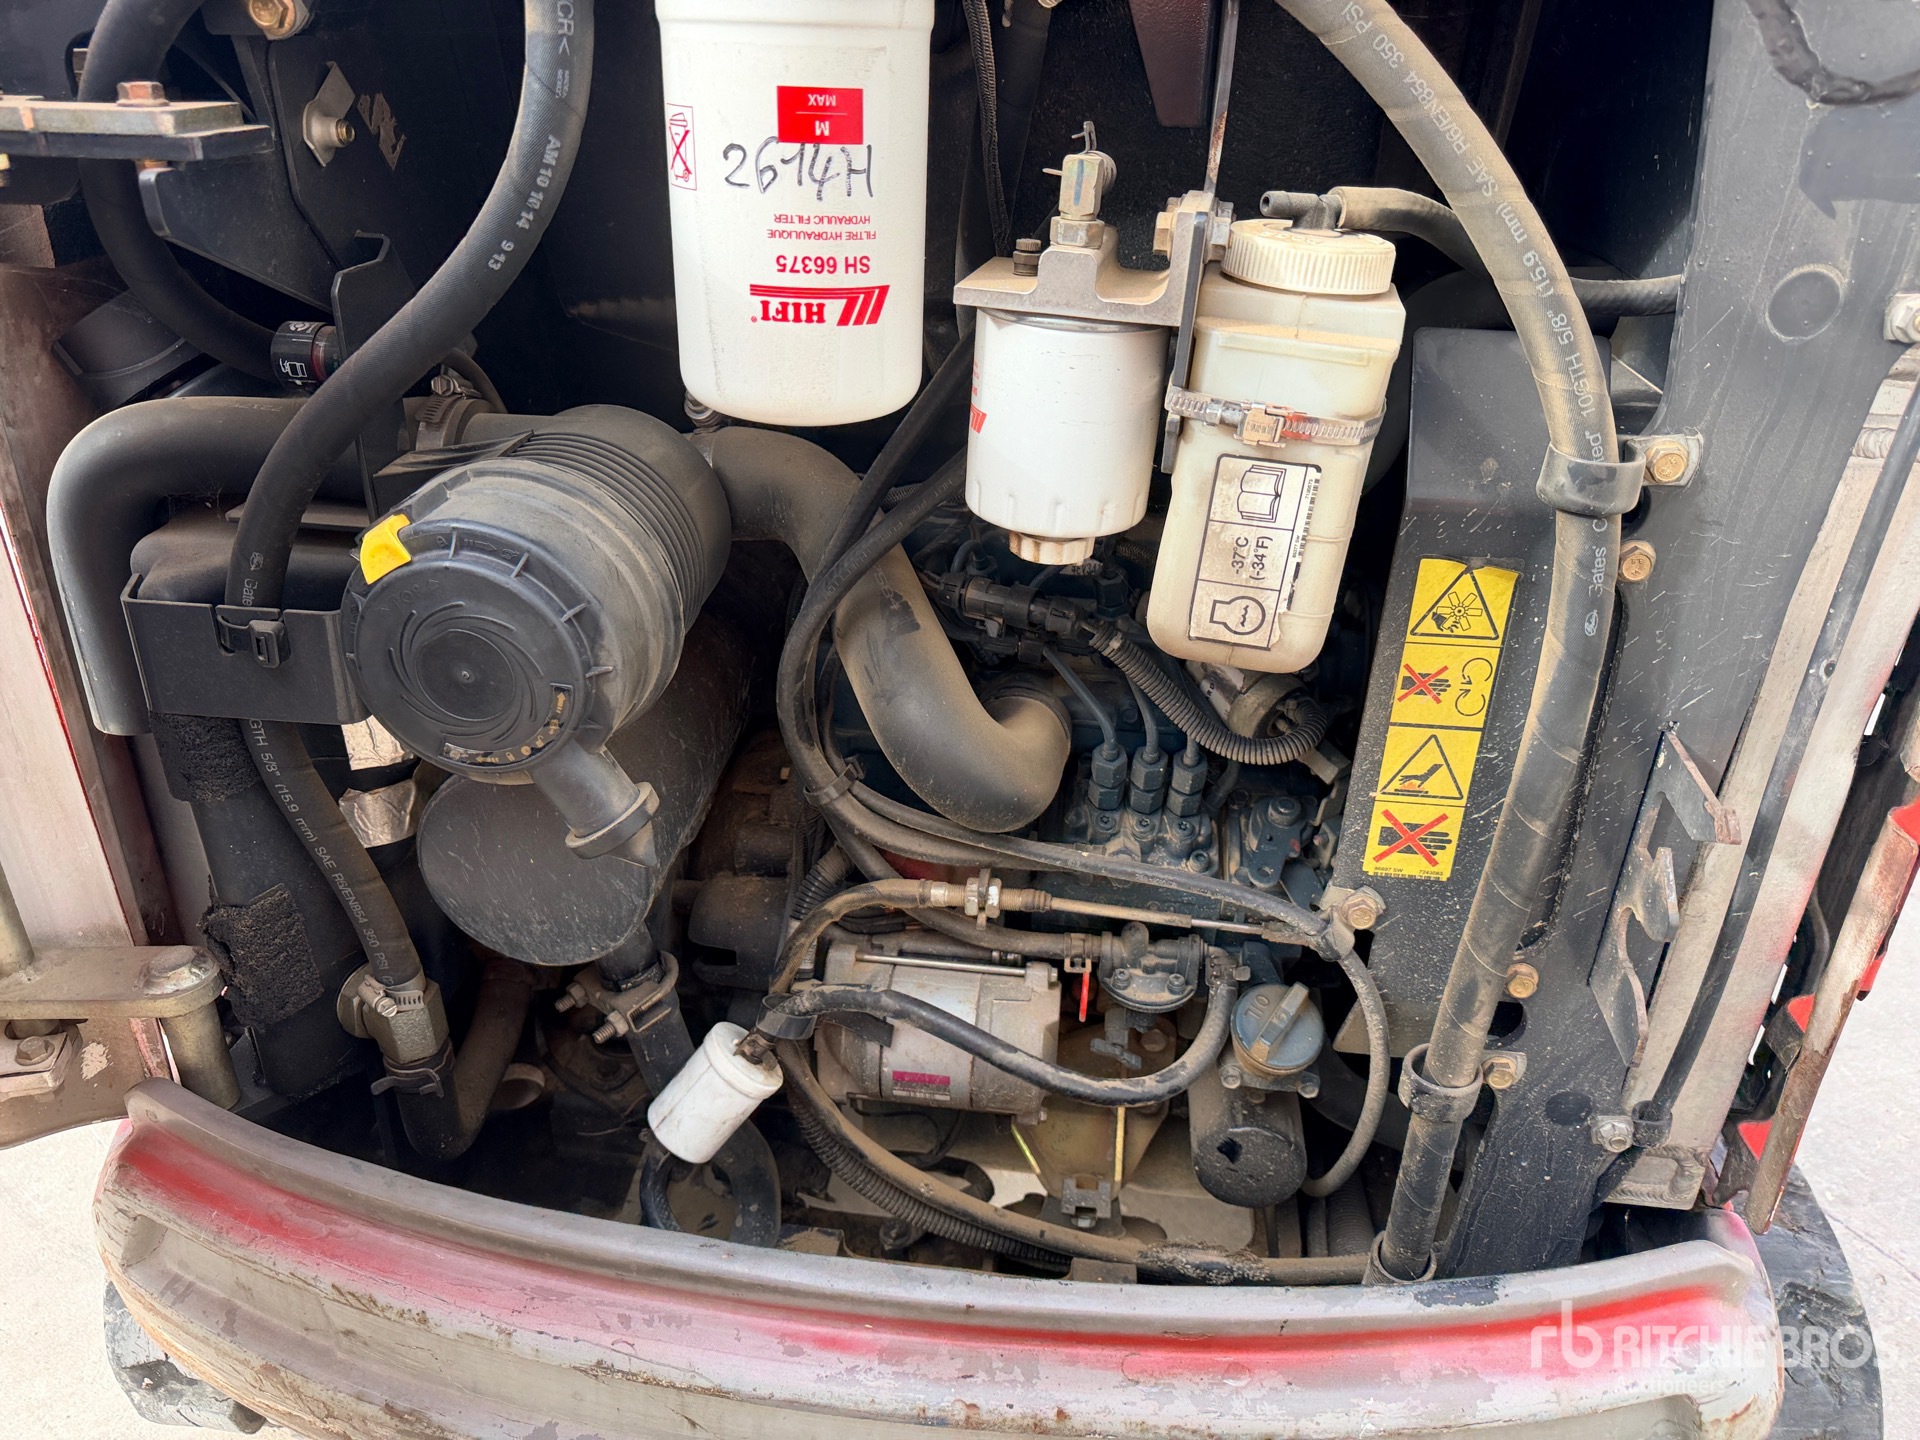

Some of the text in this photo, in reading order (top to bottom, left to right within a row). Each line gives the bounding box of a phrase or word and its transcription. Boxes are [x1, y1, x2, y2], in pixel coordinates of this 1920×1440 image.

[1340, 1, 1373, 35] PSI
[1372, 34, 1405, 70] 350
[807, 93, 837, 107] MAX
[815, 120, 830, 137] M
[773, 213, 871, 225] HYDRAULIC FILTER
[766, 228, 877, 241] FILTRE HYDRAULIQUE
[775, 255, 871, 275] SH 66375
[760, 299, 827, 324] HIFI
[1231, 536, 1249, 575] -37°C
[241, 577, 258, 607] Gate
[249, 719, 269, 747] GTH
[314, 846, 337, 870] SAE
[1244, 994, 1270, 1019] OIL
